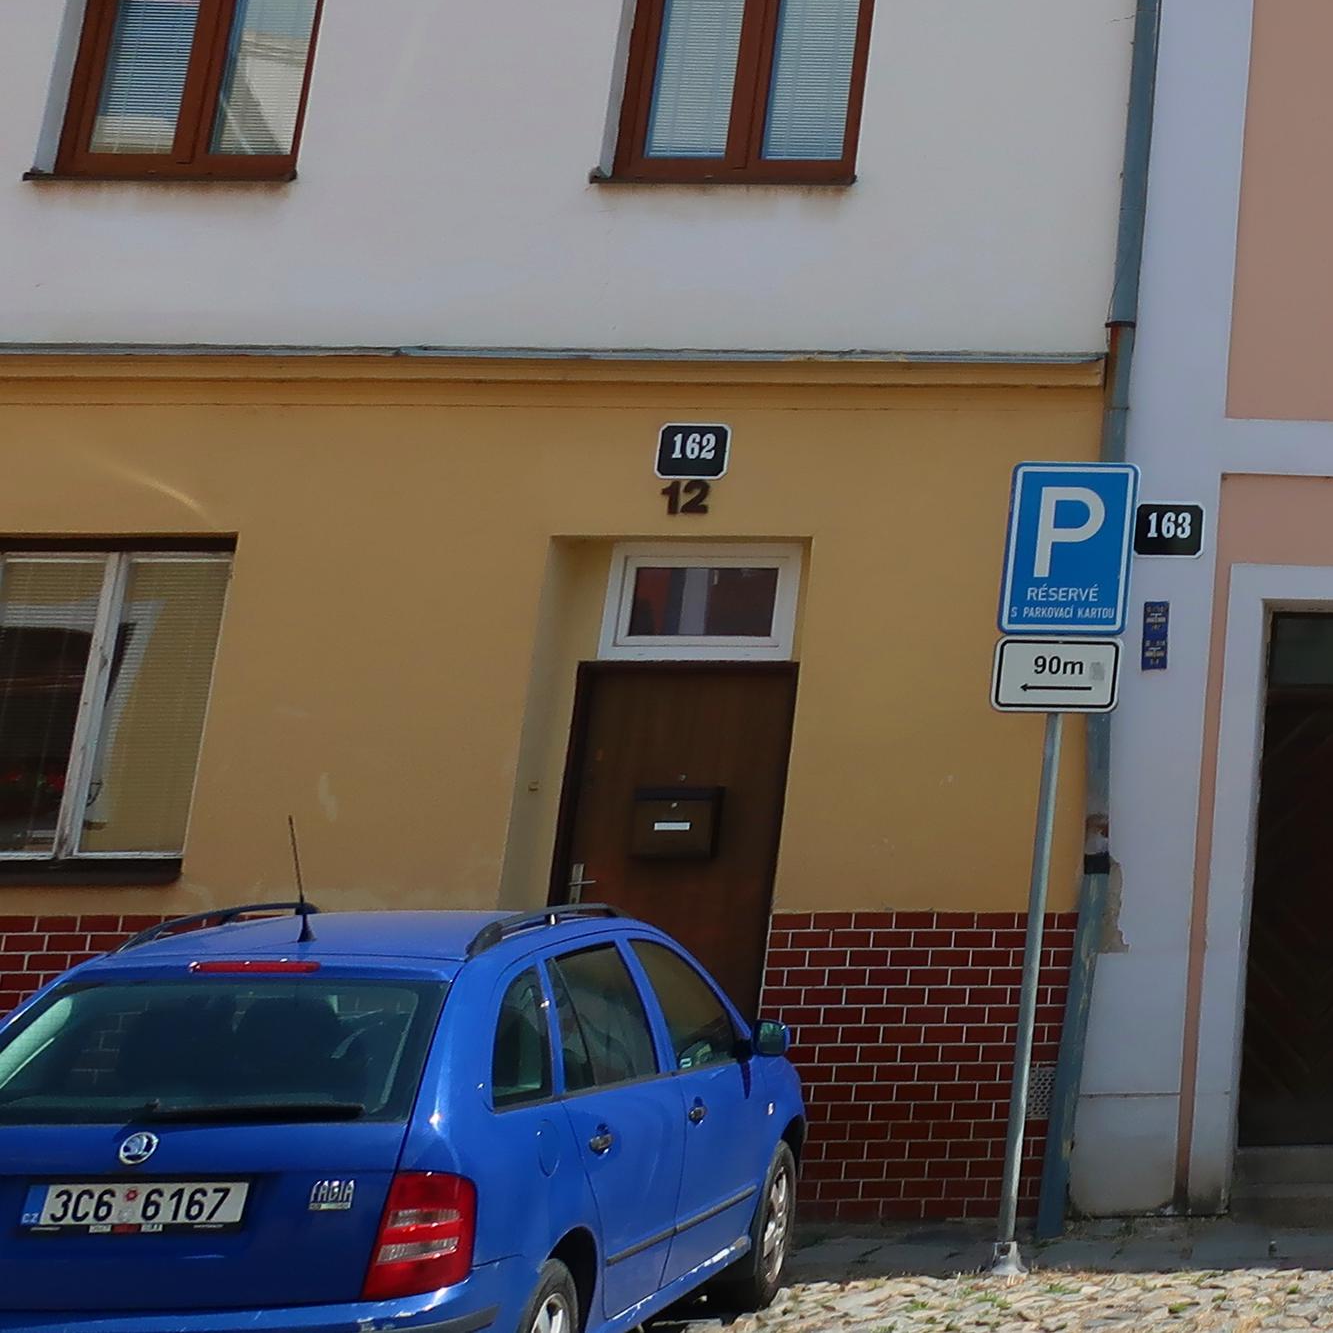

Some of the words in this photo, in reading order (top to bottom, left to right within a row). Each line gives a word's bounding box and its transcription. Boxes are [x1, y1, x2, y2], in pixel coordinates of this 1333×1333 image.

[671, 432, 717, 460] 162
[660, 479, 711, 515] 12
[1032, 485, 1106, 578] P
[1146, 511, 1192, 540] 163
[1026, 583, 1100, 602] RÉSERVÉ
[1010, 606, 1018, 618] S
[1023, 604, 1074, 619] PARKOVACÍ
[1077, 606, 1115, 619] KARTOU
[1033, 655, 1084, 676] 90m
[21, 1212, 39, 1224] CZ
[50, 1188, 116, 1222] 3C6
[141, 1187, 231, 1222] 6167
